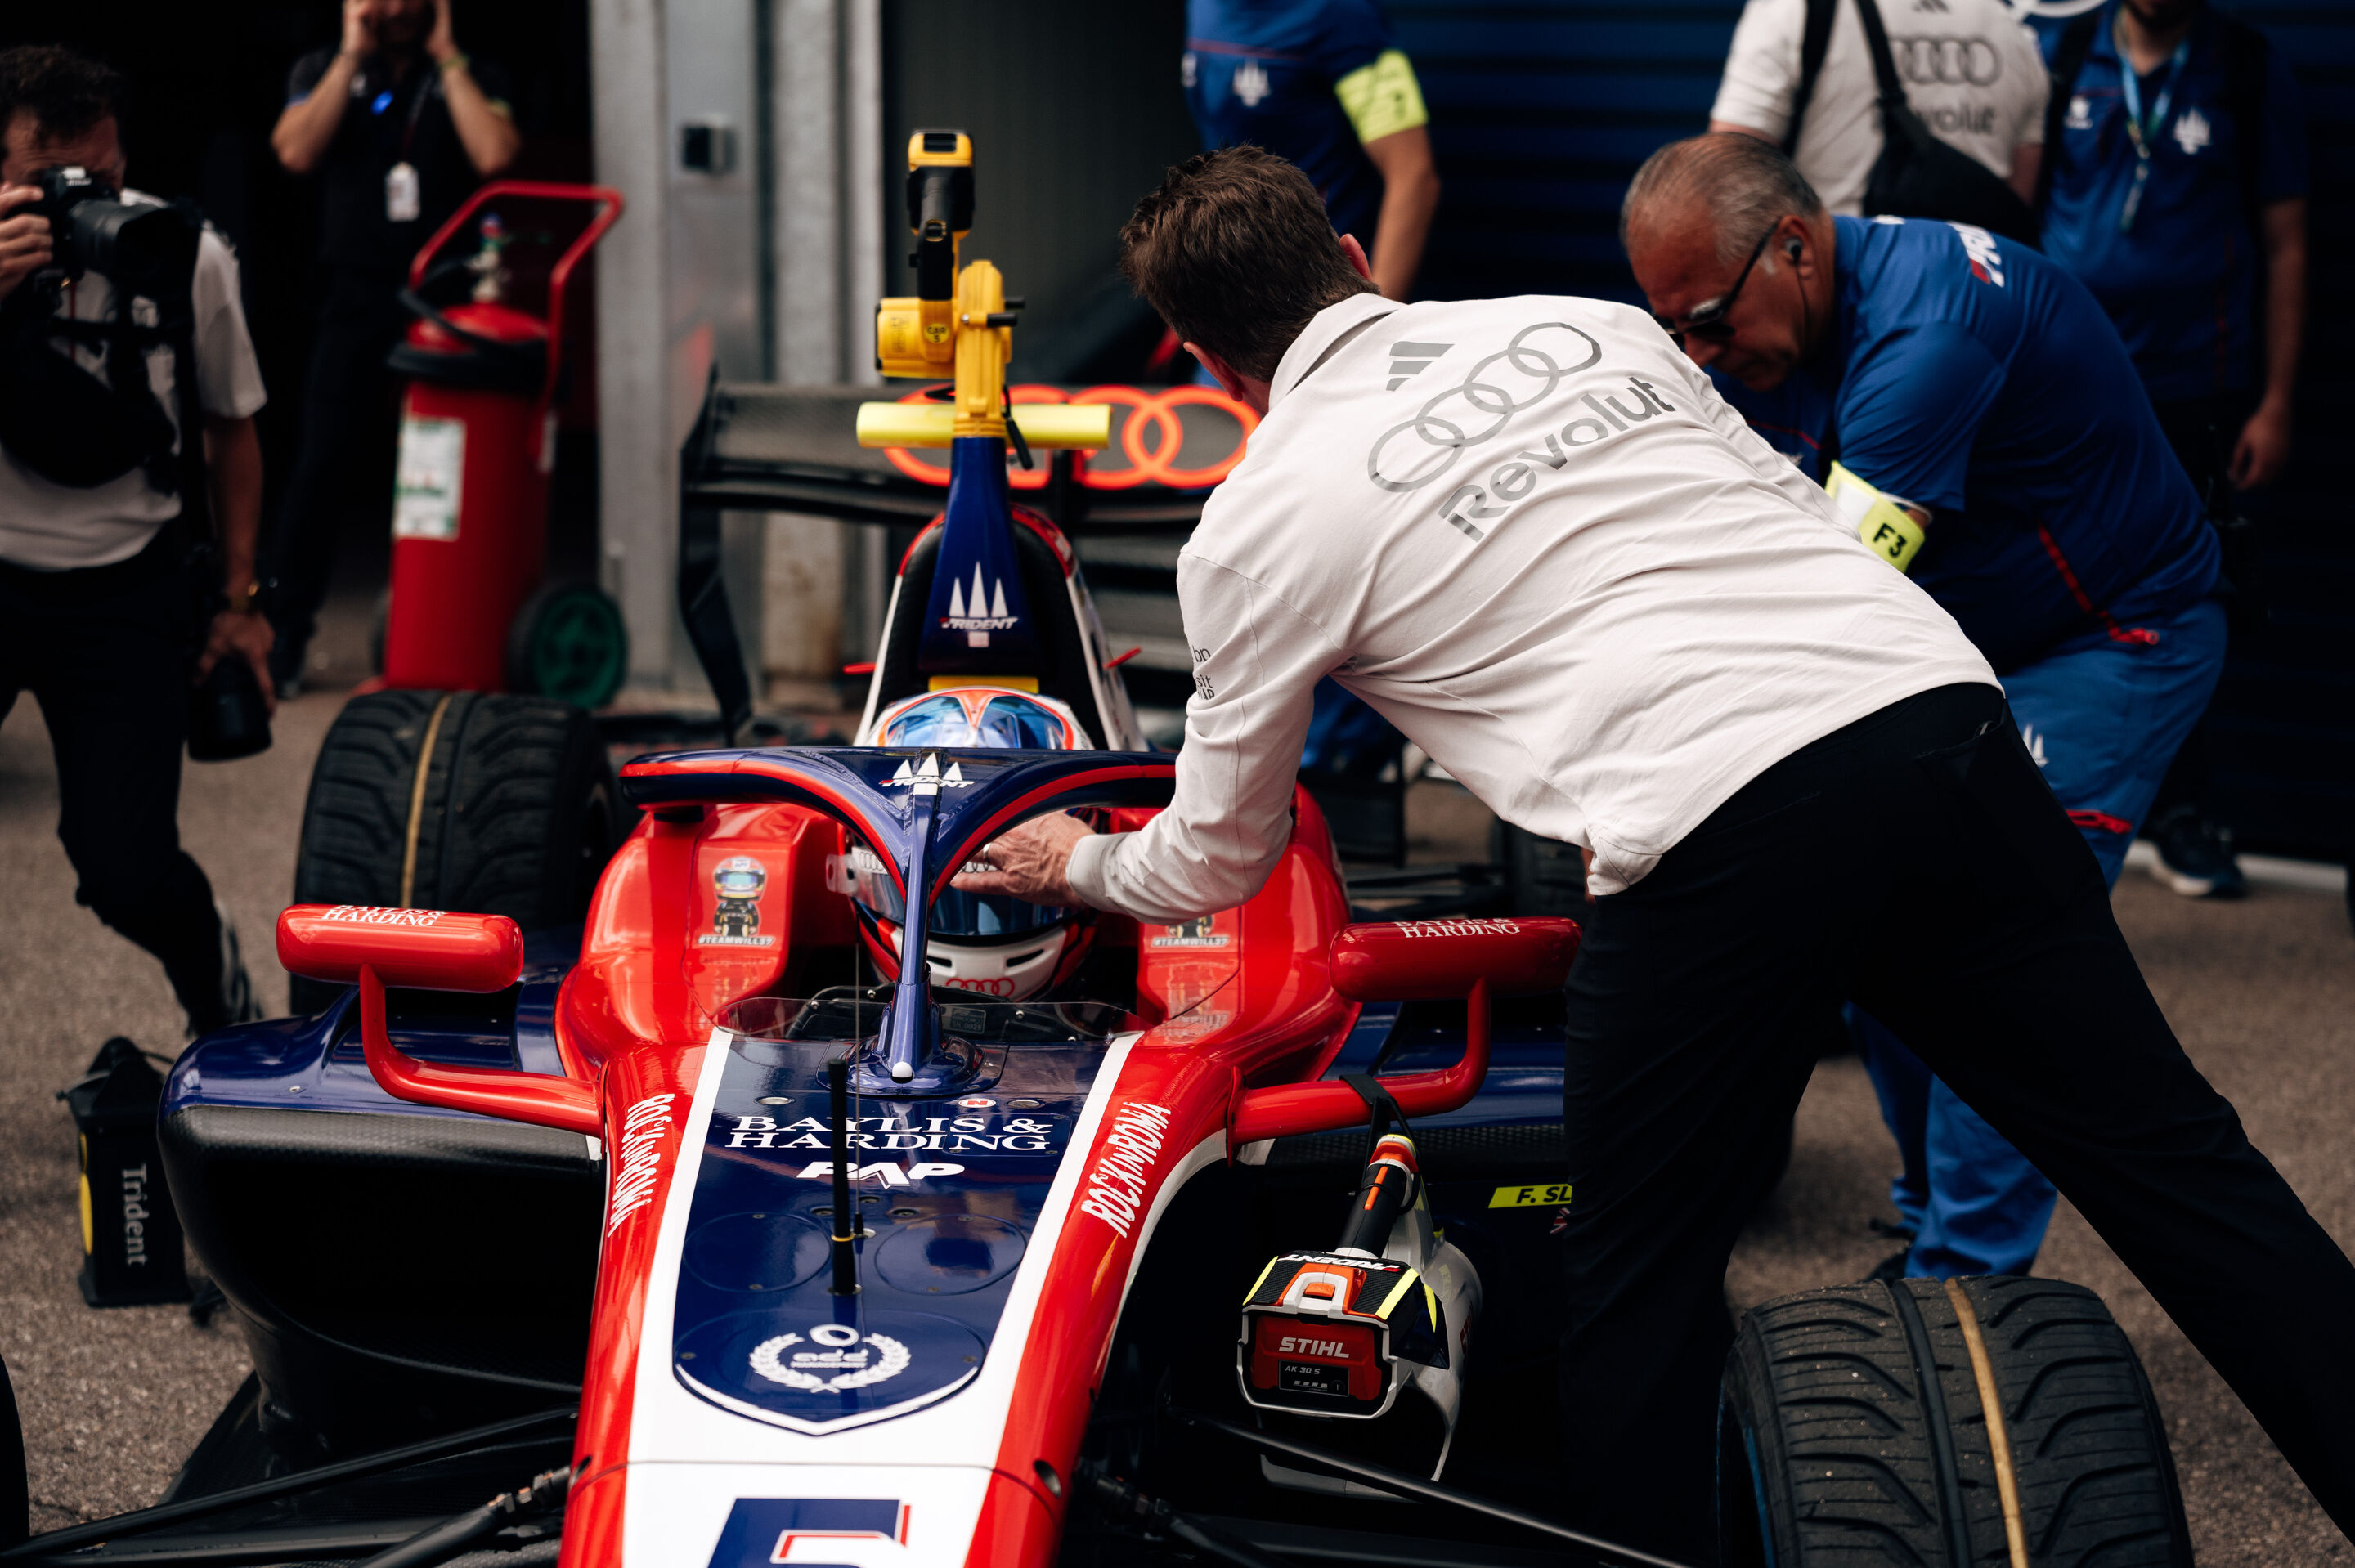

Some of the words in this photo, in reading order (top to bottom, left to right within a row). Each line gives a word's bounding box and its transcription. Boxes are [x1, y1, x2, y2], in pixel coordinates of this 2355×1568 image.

[1438, 377, 1676, 542] Revolut
[1873, 523, 1907, 558] F3
[939, 616, 1019, 630] TRIDENT
[878, 776, 975, 788] TRIDENT
[321, 909, 439, 927] HARDING
[1393, 918, 1488, 928] BAYLIS
[1400, 923, 1521, 939] HARDING
[732, 1115, 985, 1133] BAYLIS
[1003, 1118, 1054, 1135] &
[724, 1132, 1051, 1151] HARDING
[796, 1161, 966, 1189] PAP
[1516, 1187, 1536, 1204] F.
[122, 1162, 150, 1266] Trident
[1276, 1254, 1402, 1273] TRIDENT
[1278, 1337, 1350, 1359] STIHL
